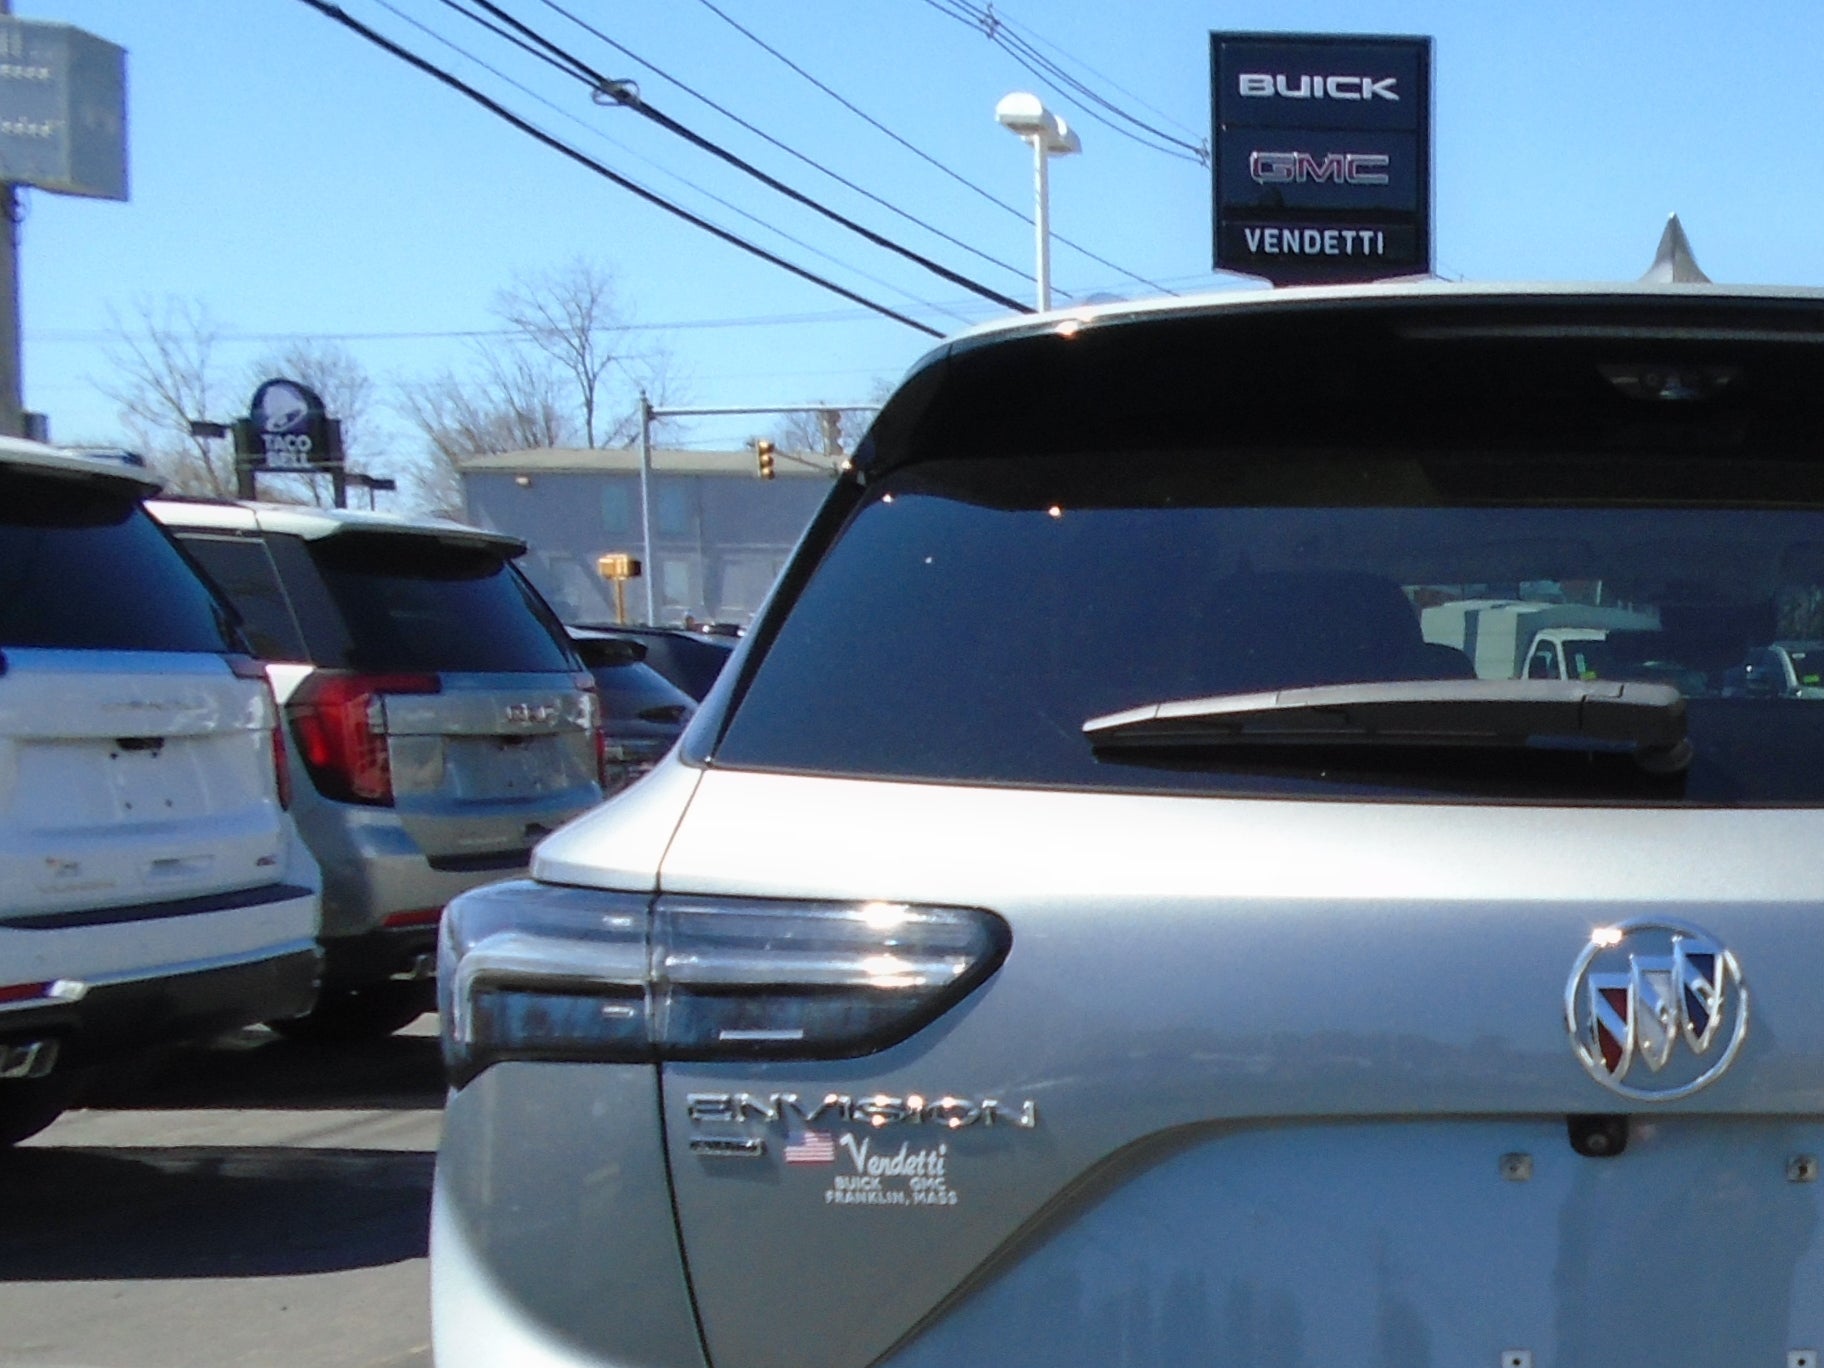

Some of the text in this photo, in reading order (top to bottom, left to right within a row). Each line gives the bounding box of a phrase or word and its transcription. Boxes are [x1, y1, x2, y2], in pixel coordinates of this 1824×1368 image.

[1238, 73, 1400, 101] BUICK
[1250, 150, 1389, 184] GMC
[1244, 228, 1384, 256] VENDETTI
[261, 433, 312, 452] TACO
[265, 451, 312, 468] BELL
[687, 1092, 1036, 1129] ENVISION
[839, 1132, 948, 1177] Vendetti
[834, 1175, 947, 1191] BUICK GMC
[913, 1190, 958, 1206] MASS
